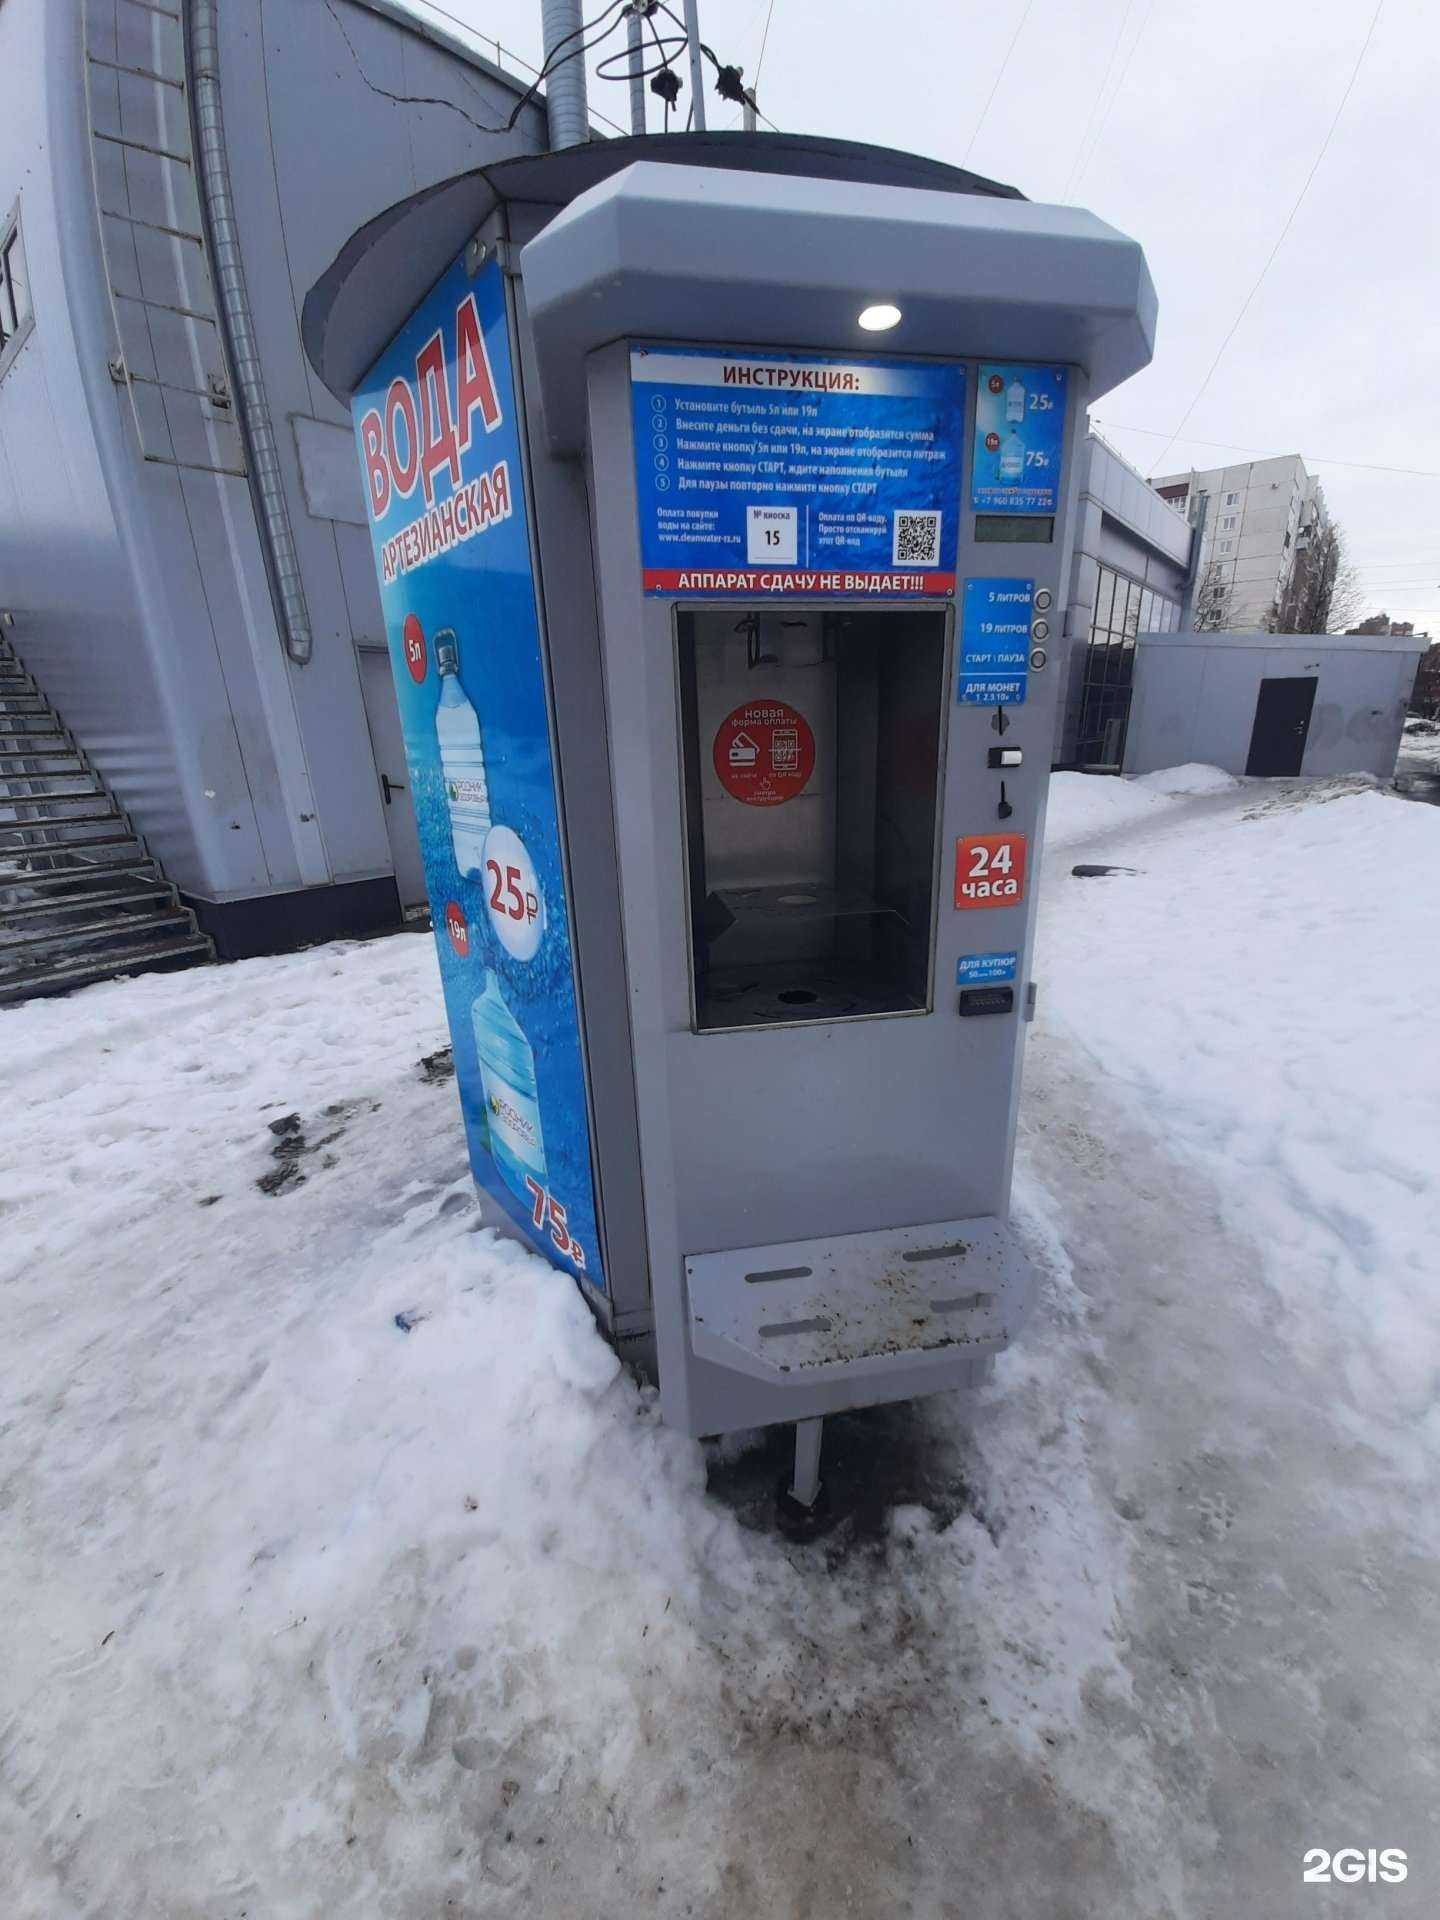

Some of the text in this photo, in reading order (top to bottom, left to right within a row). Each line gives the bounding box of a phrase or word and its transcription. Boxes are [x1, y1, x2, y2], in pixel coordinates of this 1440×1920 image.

[723, 366, 860, 391] ИНСТРУКЦИЯ:
[360, 292, 502, 521] ВОДА
[675, 398, 729, 413] Установите
[730, 401, 766, 416] бутыль
[768, 403, 780, 415] 5л
[782, 405, 799, 415] или
[801, 405, 818, 417] 19л
[675, 418, 714, 432] Внесите
[716, 422, 750, 434] деньги
[752, 422, 769, 433] без
[770, 425, 800, 437] сдачи,
[802, 427, 814, 436] на
[815, 428, 847, 439] экране
[848, 427, 904, 440] отобразится
[905, 431, 935, 443] сумма
[677, 438, 721, 451] Нажмите
[722, 444, 756, 456] кнопку
[758, 442, 769, 453] 5л
[770, 445, 788, 454] или
[790, 443, 808, 457] 19л,
[811, 446, 822, 456] на
[823, 447, 856, 458] экране
[857, 446, 912, 459] отобразится
[678, 458, 721, 471] Нажмите
[723, 463, 756, 475] кнопку
[757, 461, 786, 475] СТАРТ,
[788, 465, 817, 476] ждите
[819, 465, 874, 477] наполнения
[678, 477, 697, 490] Для
[700, 479, 728, 492] паузы
[730, 481, 774, 493] повторно
[775, 483, 817, 493] нажмите
[818, 484, 850, 496] кнопку
[852, 483, 877, 494] СТАРТ
[381, 459, 512, 585] АРТЕЗИАНСКАЯ
[657, 506, 718, 520] Оплата покупки
[764, 512, 790, 520] киоска
[818, 511, 844, 522] Оплата
[658, 522, 715, 531] воды на сайте:
[818, 523, 887, 536] Просто отсканируй
[765, 530, 780, 545] 15
[678, 573, 924, 592] АППАРАТ СДАЧУ НЕ ВЫДАЕТ!!!
[988, 592, 1031, 602] 5 ЛИТРОВ
[980, 623, 1028, 634] 19 ЛИТРОВ
[408, 639, 423, 662] 5л
[965, 654, 991, 663] СТАРТ
[997, 654, 1025, 663] ПАУЗА
[965, 682, 1021, 693] ДЛЯ МОНЕТ
[968, 845, 1013, 878] 24
[962, 878, 1017, 899] часа
[450, 919, 468, 943] 19л
[959, 957, 1016, 970] ДЛЯ КУПЮР
